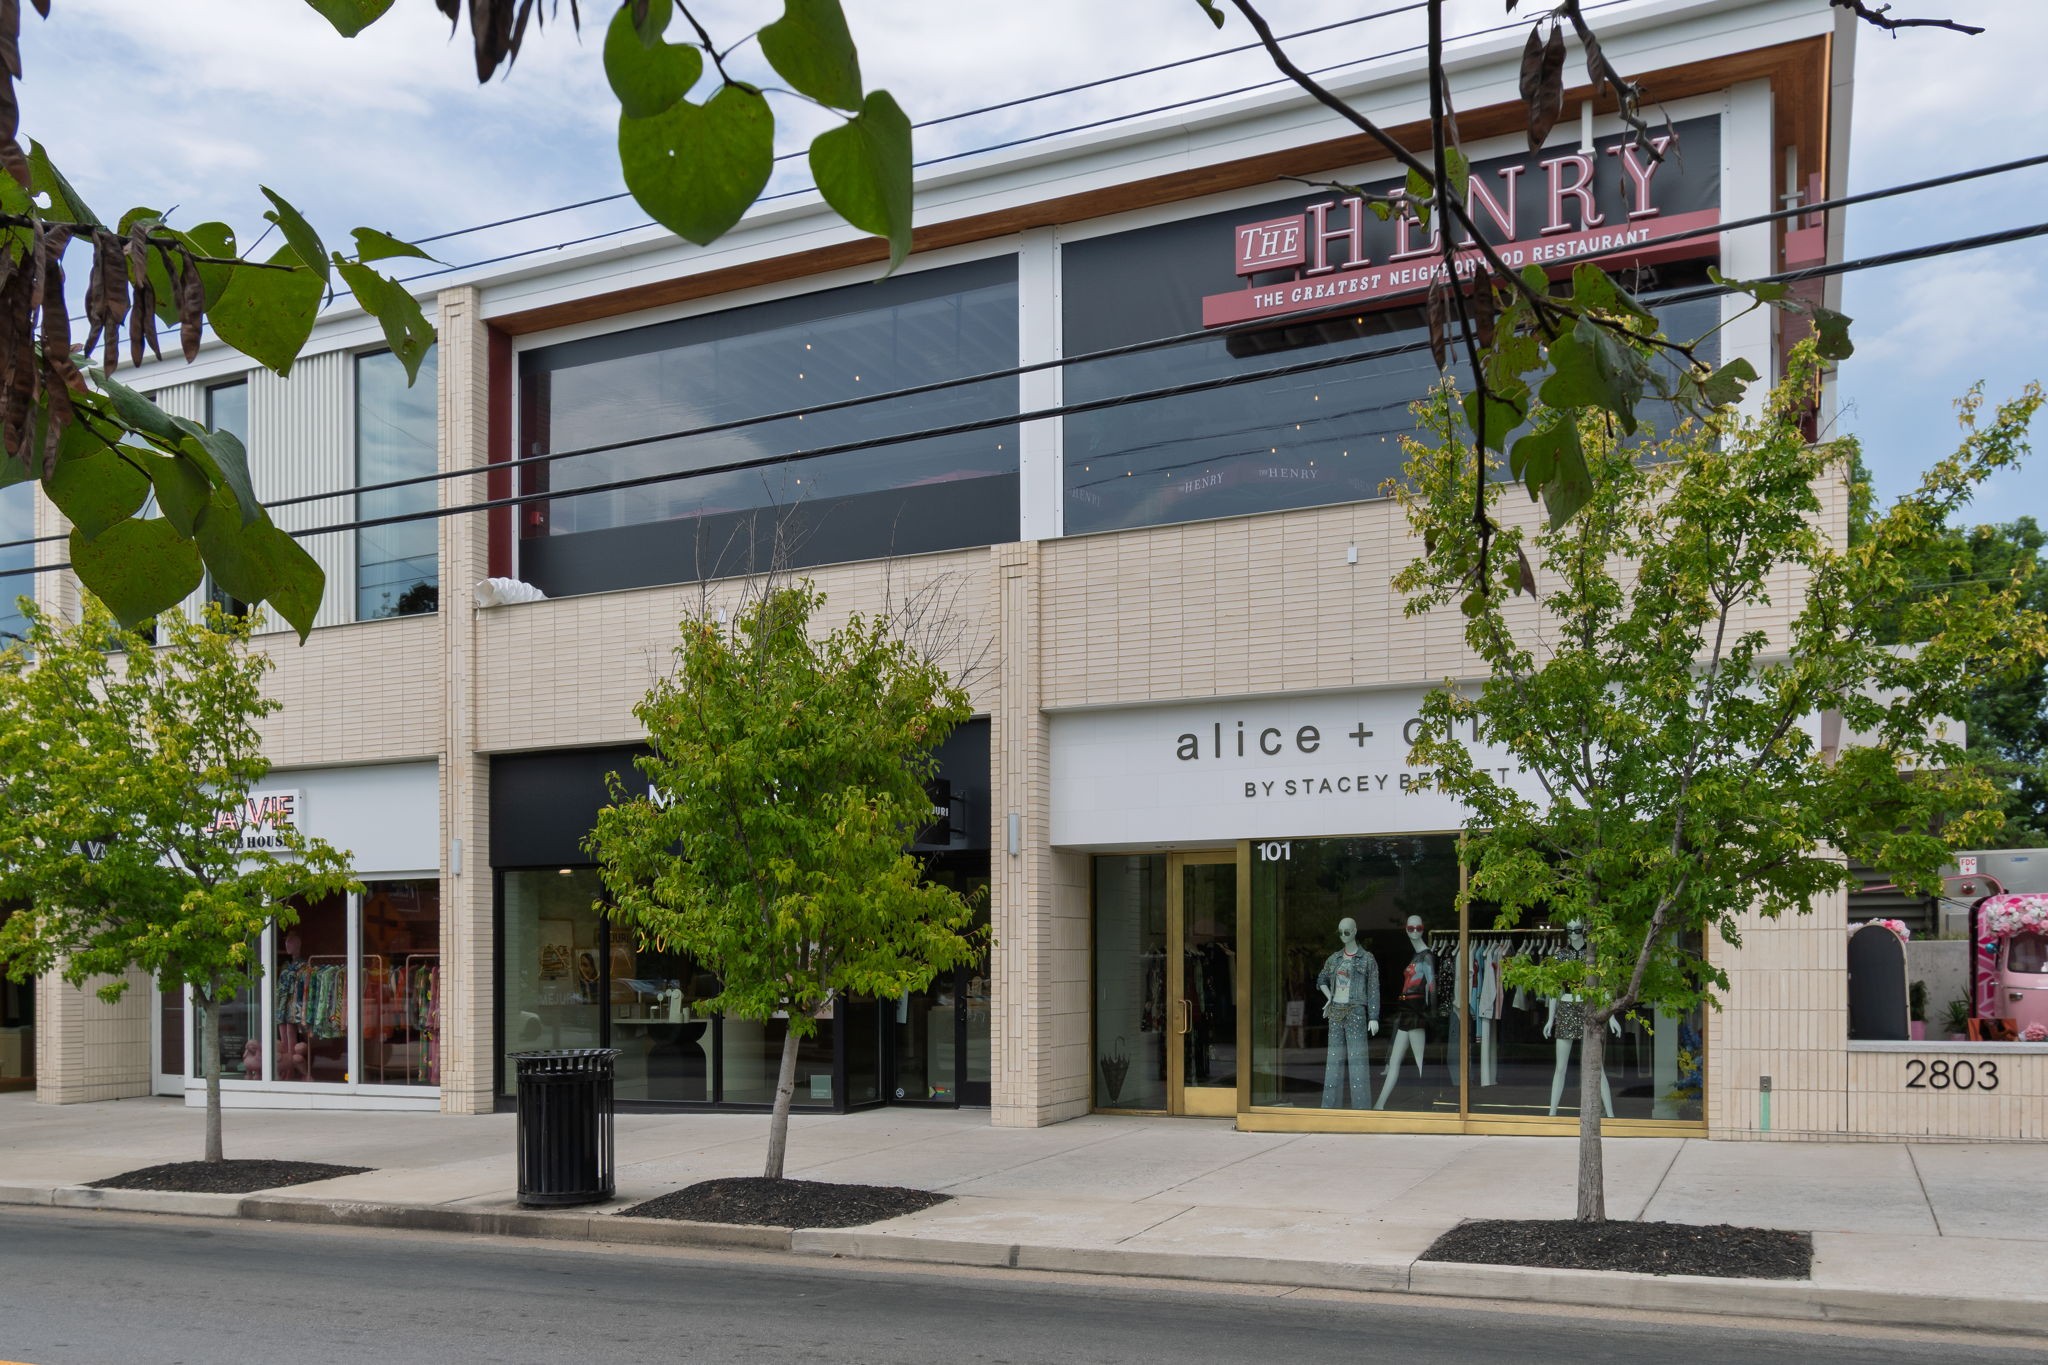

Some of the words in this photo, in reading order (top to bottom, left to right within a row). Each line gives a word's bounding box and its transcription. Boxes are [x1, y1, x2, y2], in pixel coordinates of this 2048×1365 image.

[1241, 227, 1299, 260] THE
[1306, 133, 1679, 276] HENRY
[1254, 292, 1284, 309] THE
[1291, 274, 1381, 303] GREATEST
[1389, 249, 1524, 286] NEIGHBORHOD
[1532, 228, 1650, 262] RESTAURANT
[1185, 472, 1225, 494] HENRY
[1269, 467, 1319, 480] HENRY
[1176, 720, 1321, 761] alice
[1244, 780, 1275, 798] BY
[1284, 774, 1389, 796] STACEY
[1257, 841, 1291, 861] 101
[1960, 858, 1976, 866] FDC
[1905, 1058, 2000, 1091] 2803
